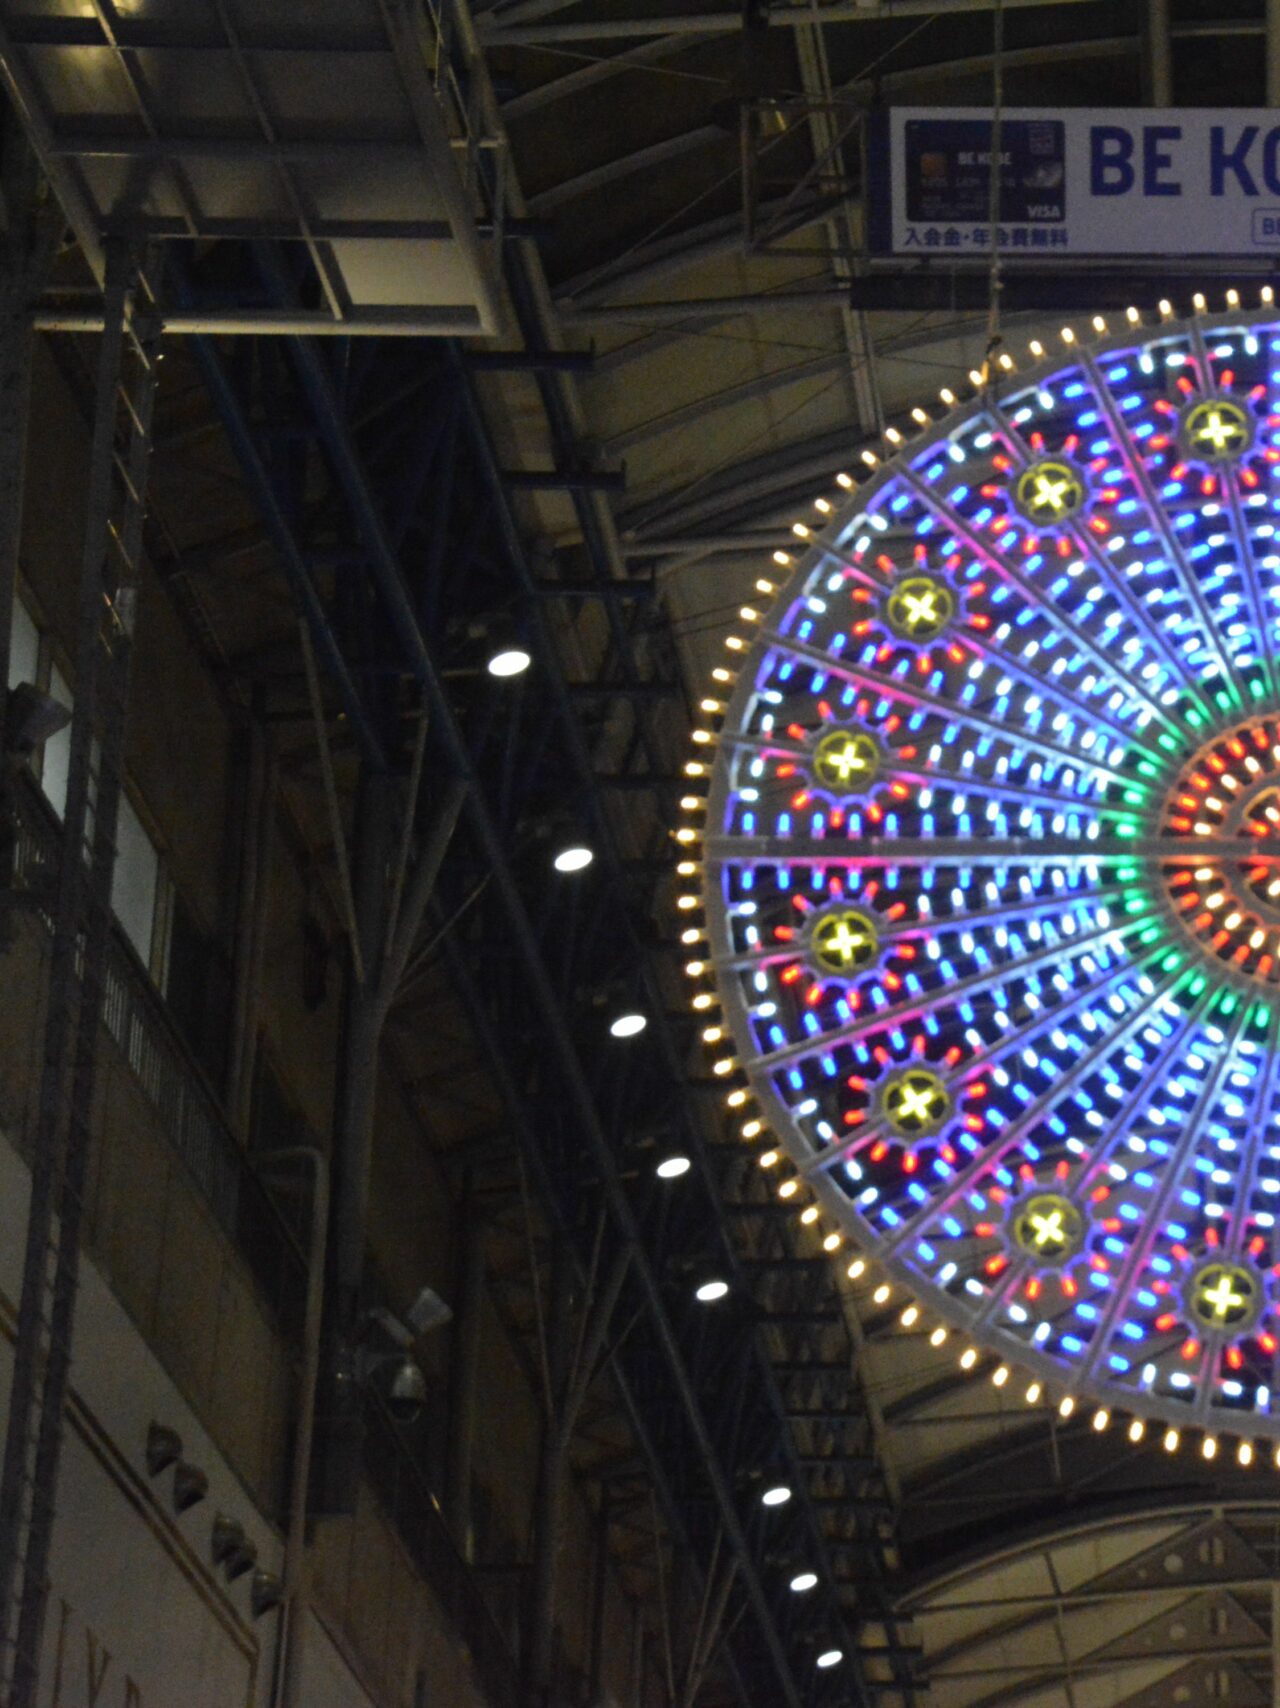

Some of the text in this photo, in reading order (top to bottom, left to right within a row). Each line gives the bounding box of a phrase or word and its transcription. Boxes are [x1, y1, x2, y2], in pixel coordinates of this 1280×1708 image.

[957, 151, 976, 165] BE
[1090, 126, 1182, 196] BE
[1028, 205, 1060, 218] VISA
